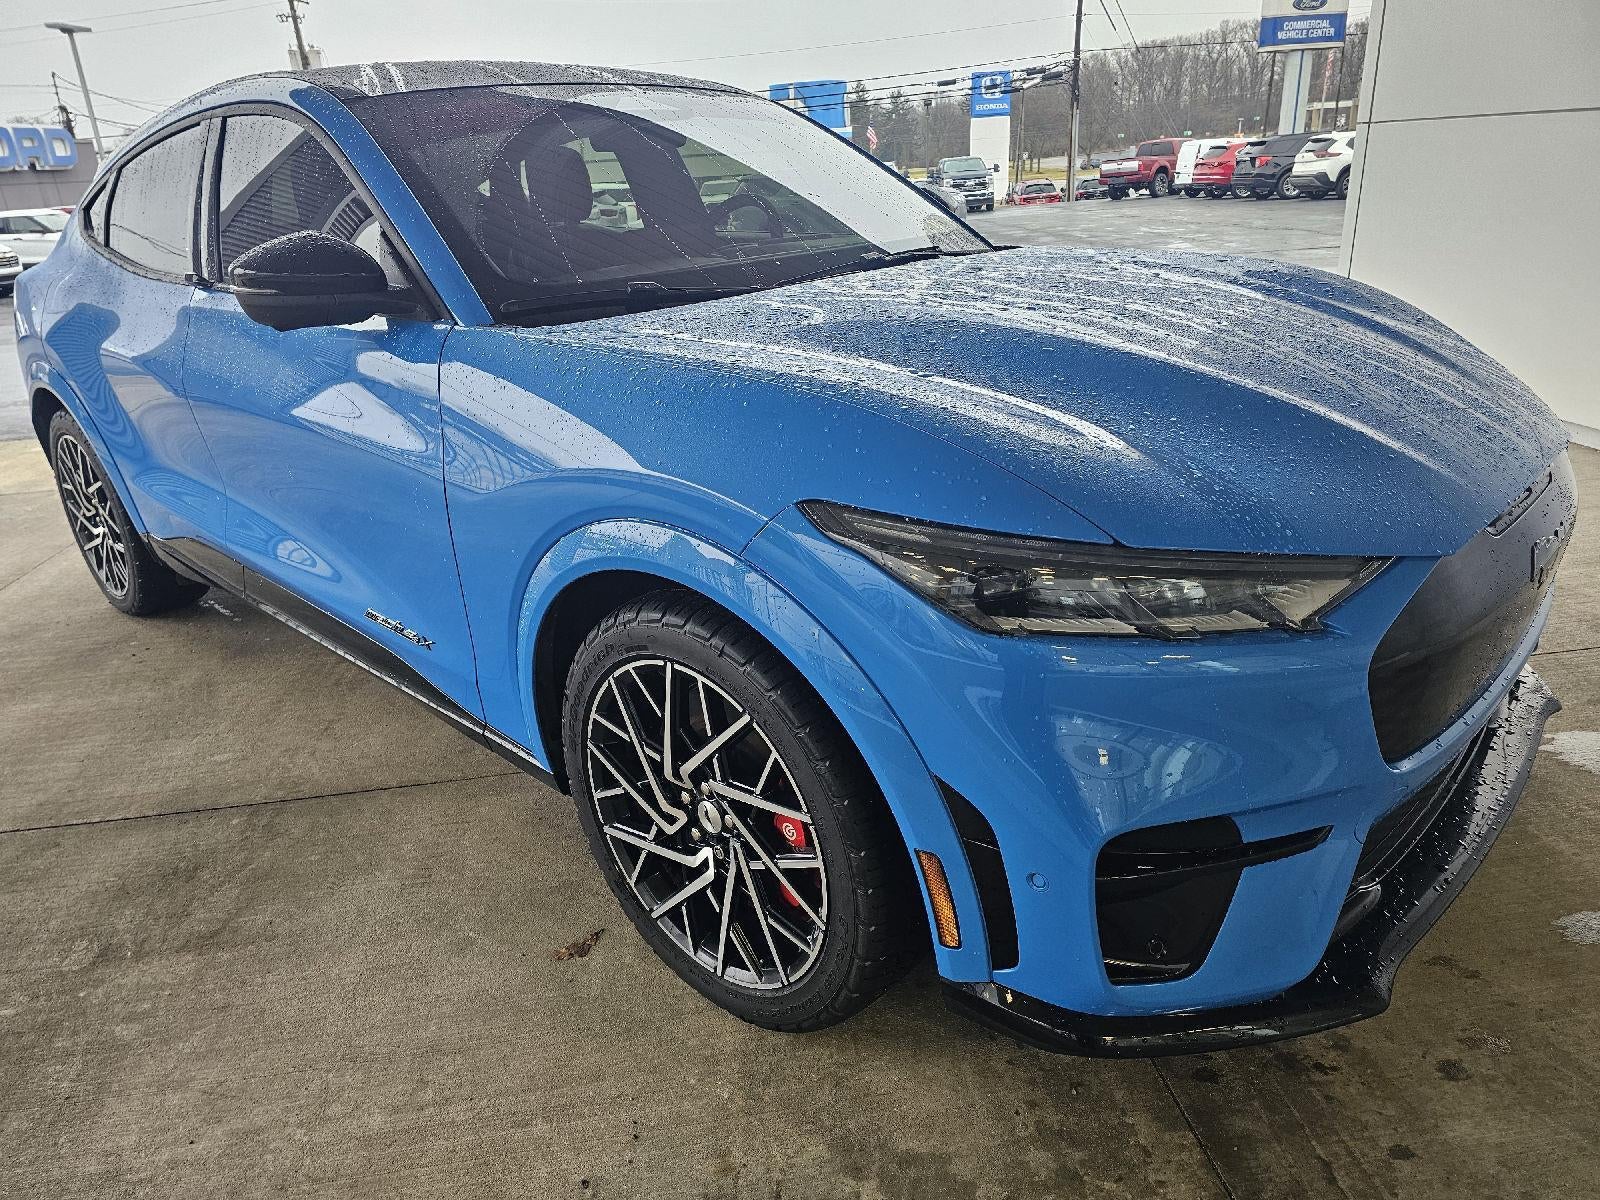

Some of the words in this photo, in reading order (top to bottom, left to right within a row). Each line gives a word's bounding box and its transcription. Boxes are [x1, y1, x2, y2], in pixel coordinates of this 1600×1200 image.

[1283, 19, 1331, 31] COMMERCIAL
[1277, 28, 1308, 40] VEHICLE
[1308, 27, 1335, 38] CENTER
[975, 103, 1009, 111] HONDA
